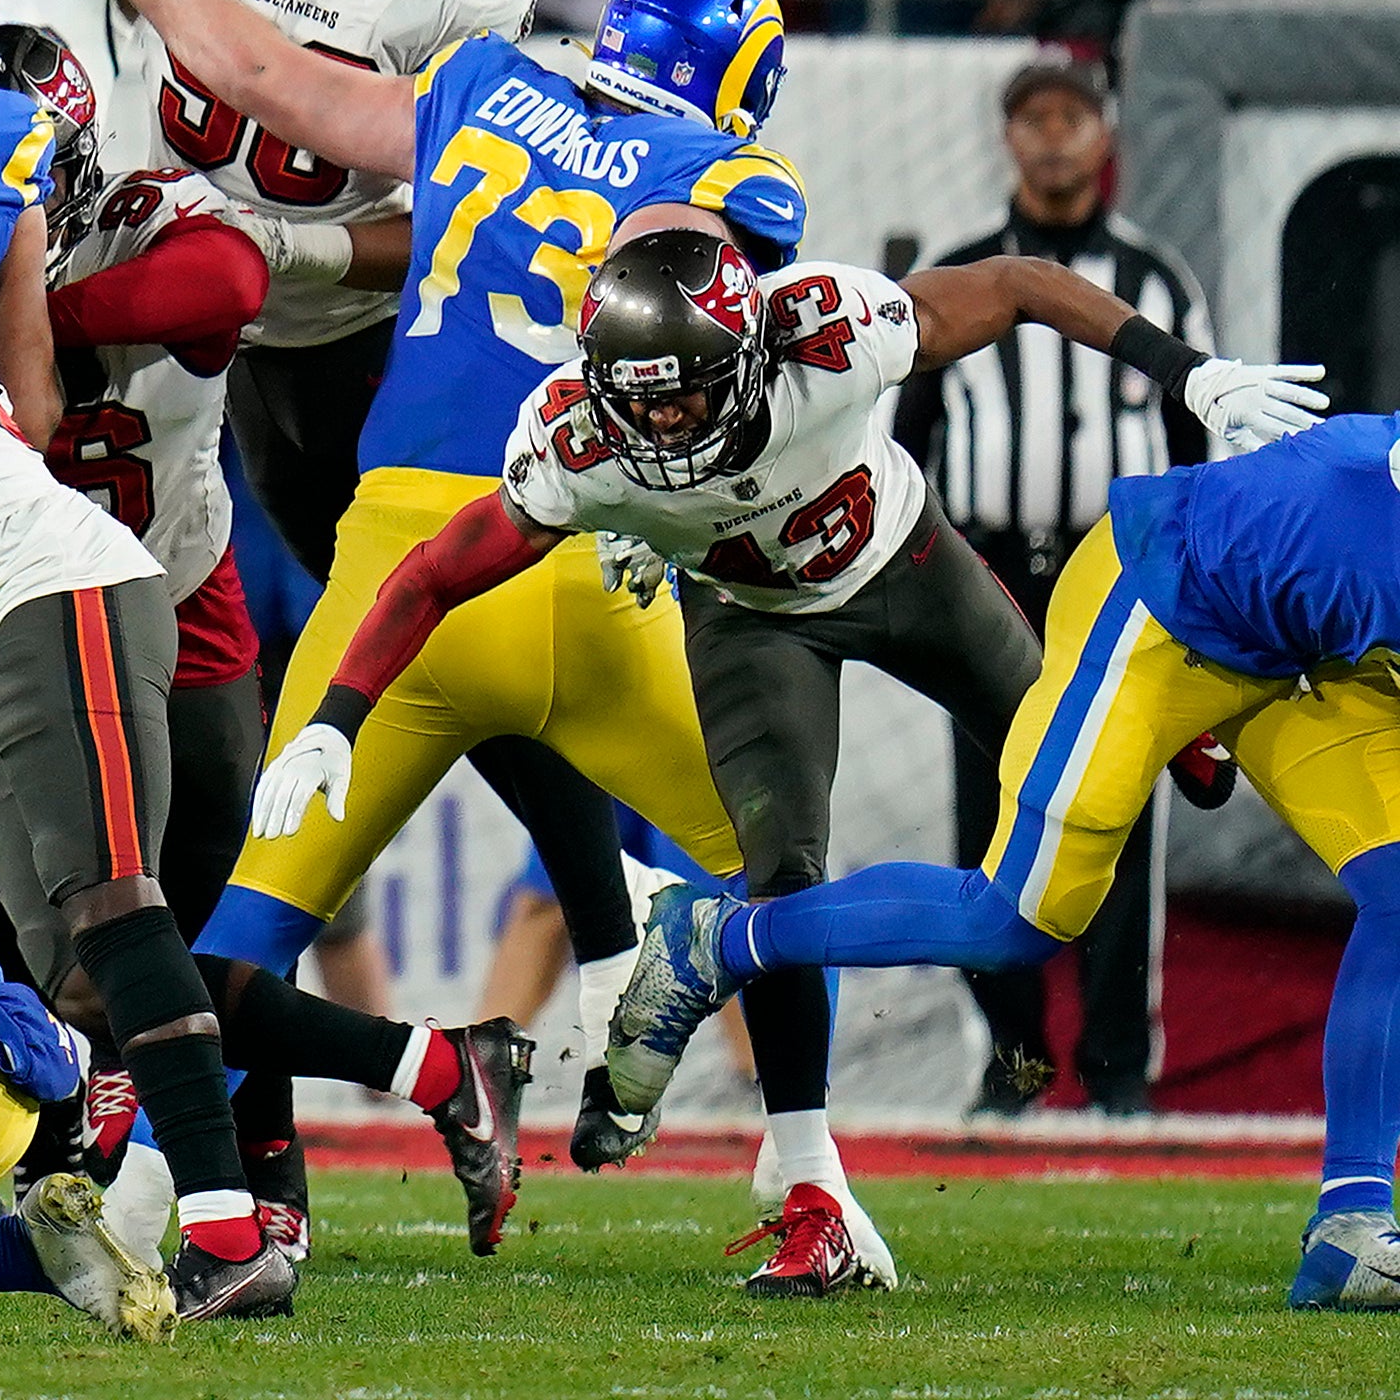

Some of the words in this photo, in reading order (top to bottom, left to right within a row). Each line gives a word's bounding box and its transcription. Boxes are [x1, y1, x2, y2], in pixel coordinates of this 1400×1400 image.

[590, 70, 612, 87] LOS
[614, 82, 686, 118] ANGELES
[406, 124, 618, 364] 73
[771, 273, 856, 374] 43
[712, 486, 803, 534] BUCCANEERS
